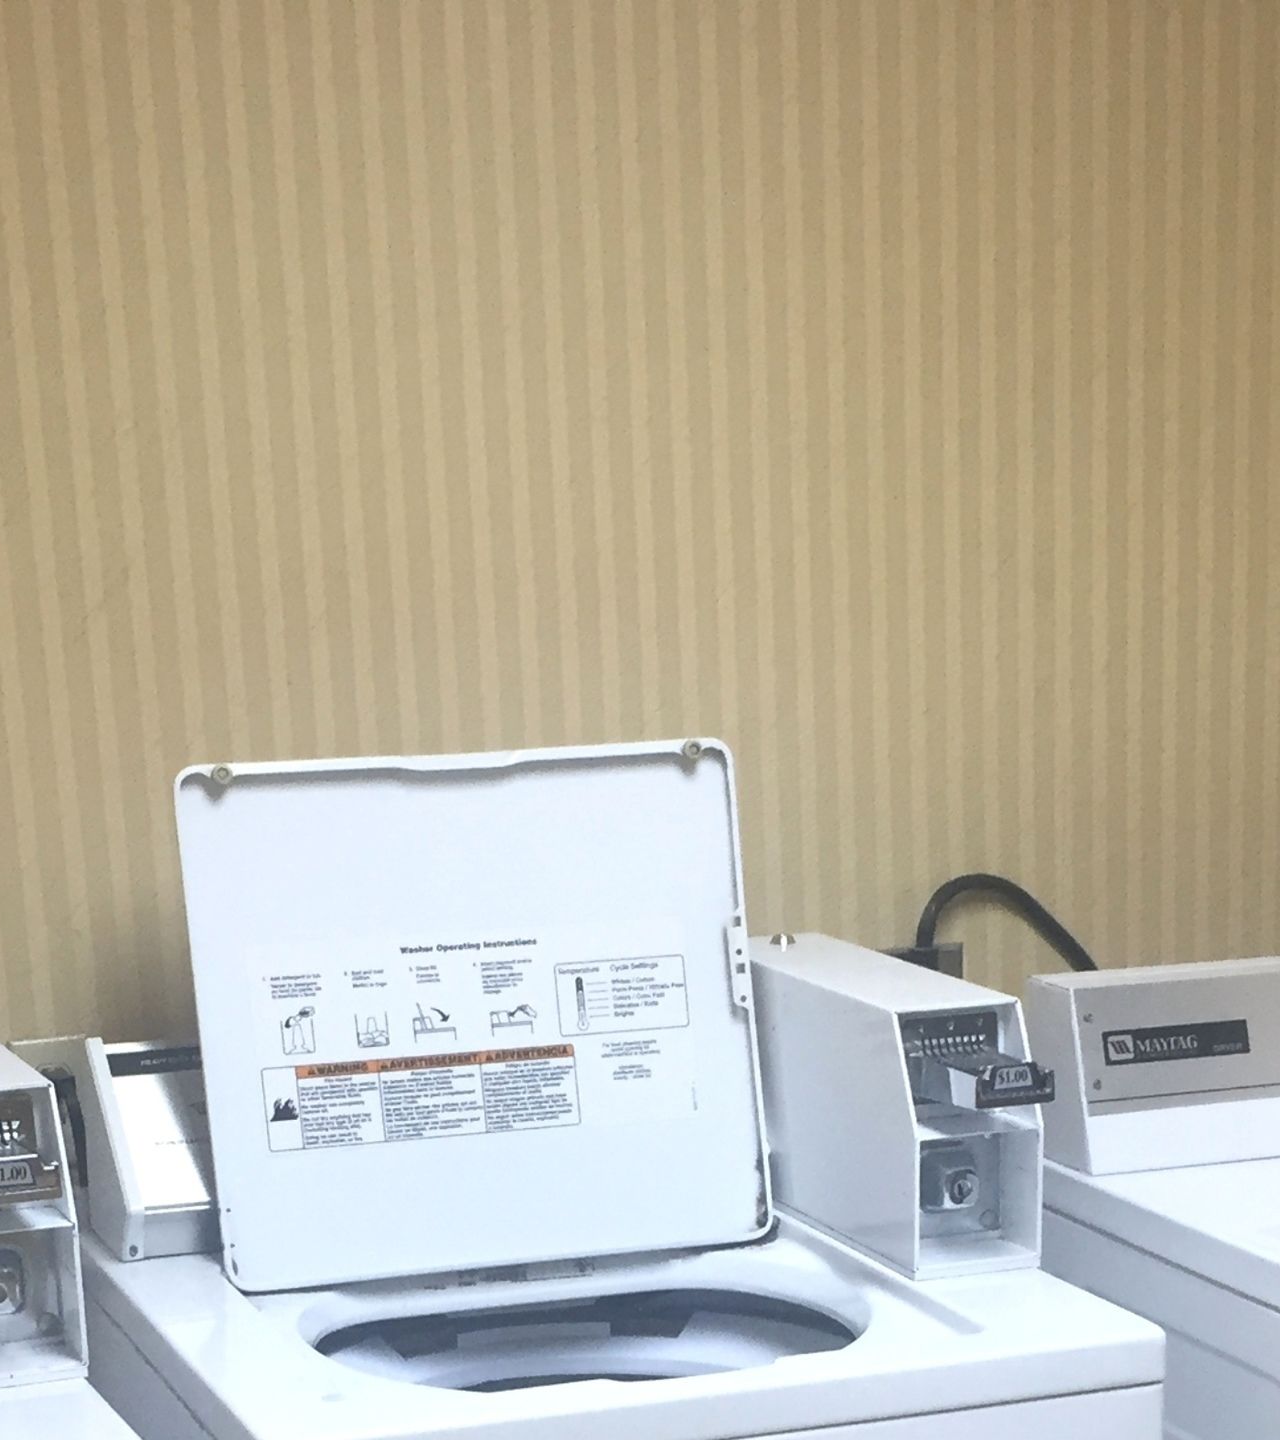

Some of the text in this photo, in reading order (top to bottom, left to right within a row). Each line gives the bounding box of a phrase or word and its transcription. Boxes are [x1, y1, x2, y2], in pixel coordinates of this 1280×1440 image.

[400, 938, 537, 954] Washer Operating Instructions
[1136, 1035, 1199, 1053] MAYTAG
[998, 1067, 1029, 1085] $1.00
